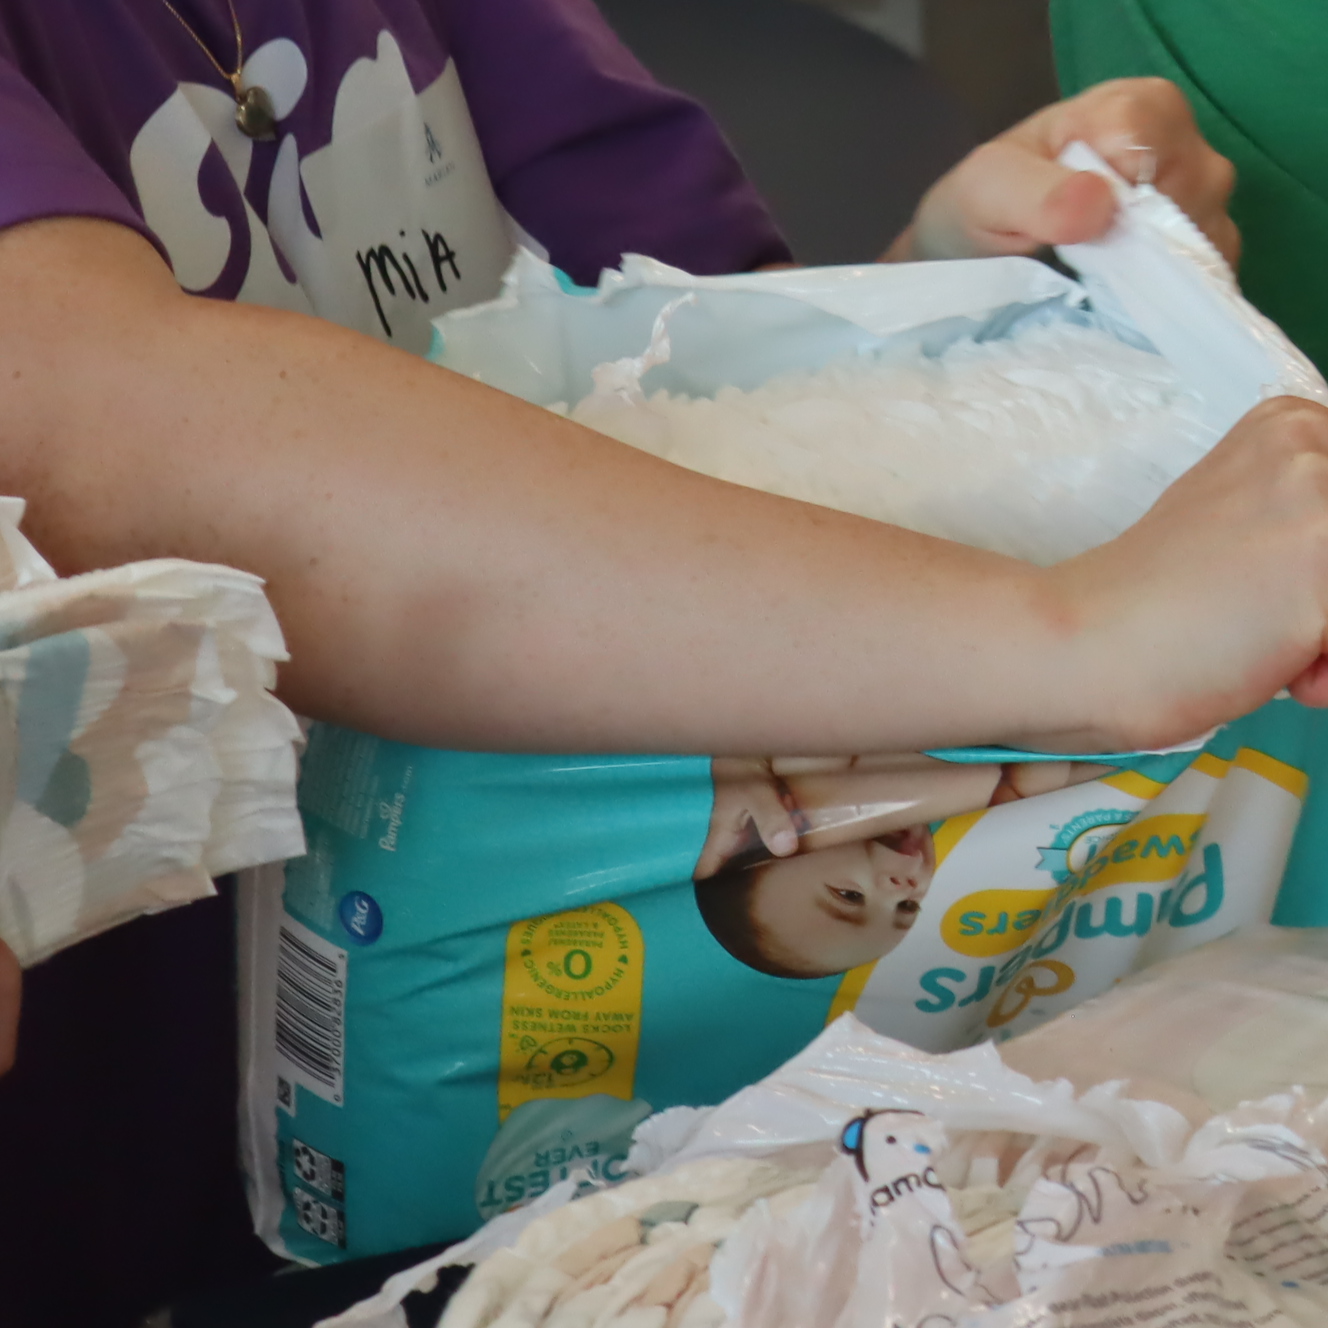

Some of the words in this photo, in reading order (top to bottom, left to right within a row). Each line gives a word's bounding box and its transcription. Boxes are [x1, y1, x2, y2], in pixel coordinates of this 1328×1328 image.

[350, 895, 370, 936] P&G
[523, 958, 625, 1001] HYPOALLERGENIC
[510, 1005, 543, 1018] SKIN
[548, 1008, 590, 1022] FROM
[595, 1011, 635, 1022] AWAY
[512, 1019, 578, 1034] WETNESS
[582, 1023, 632, 1034] LOCKS
[533, 1140, 600, 1168] EVER
[479, 1153, 630, 1208] OEST
